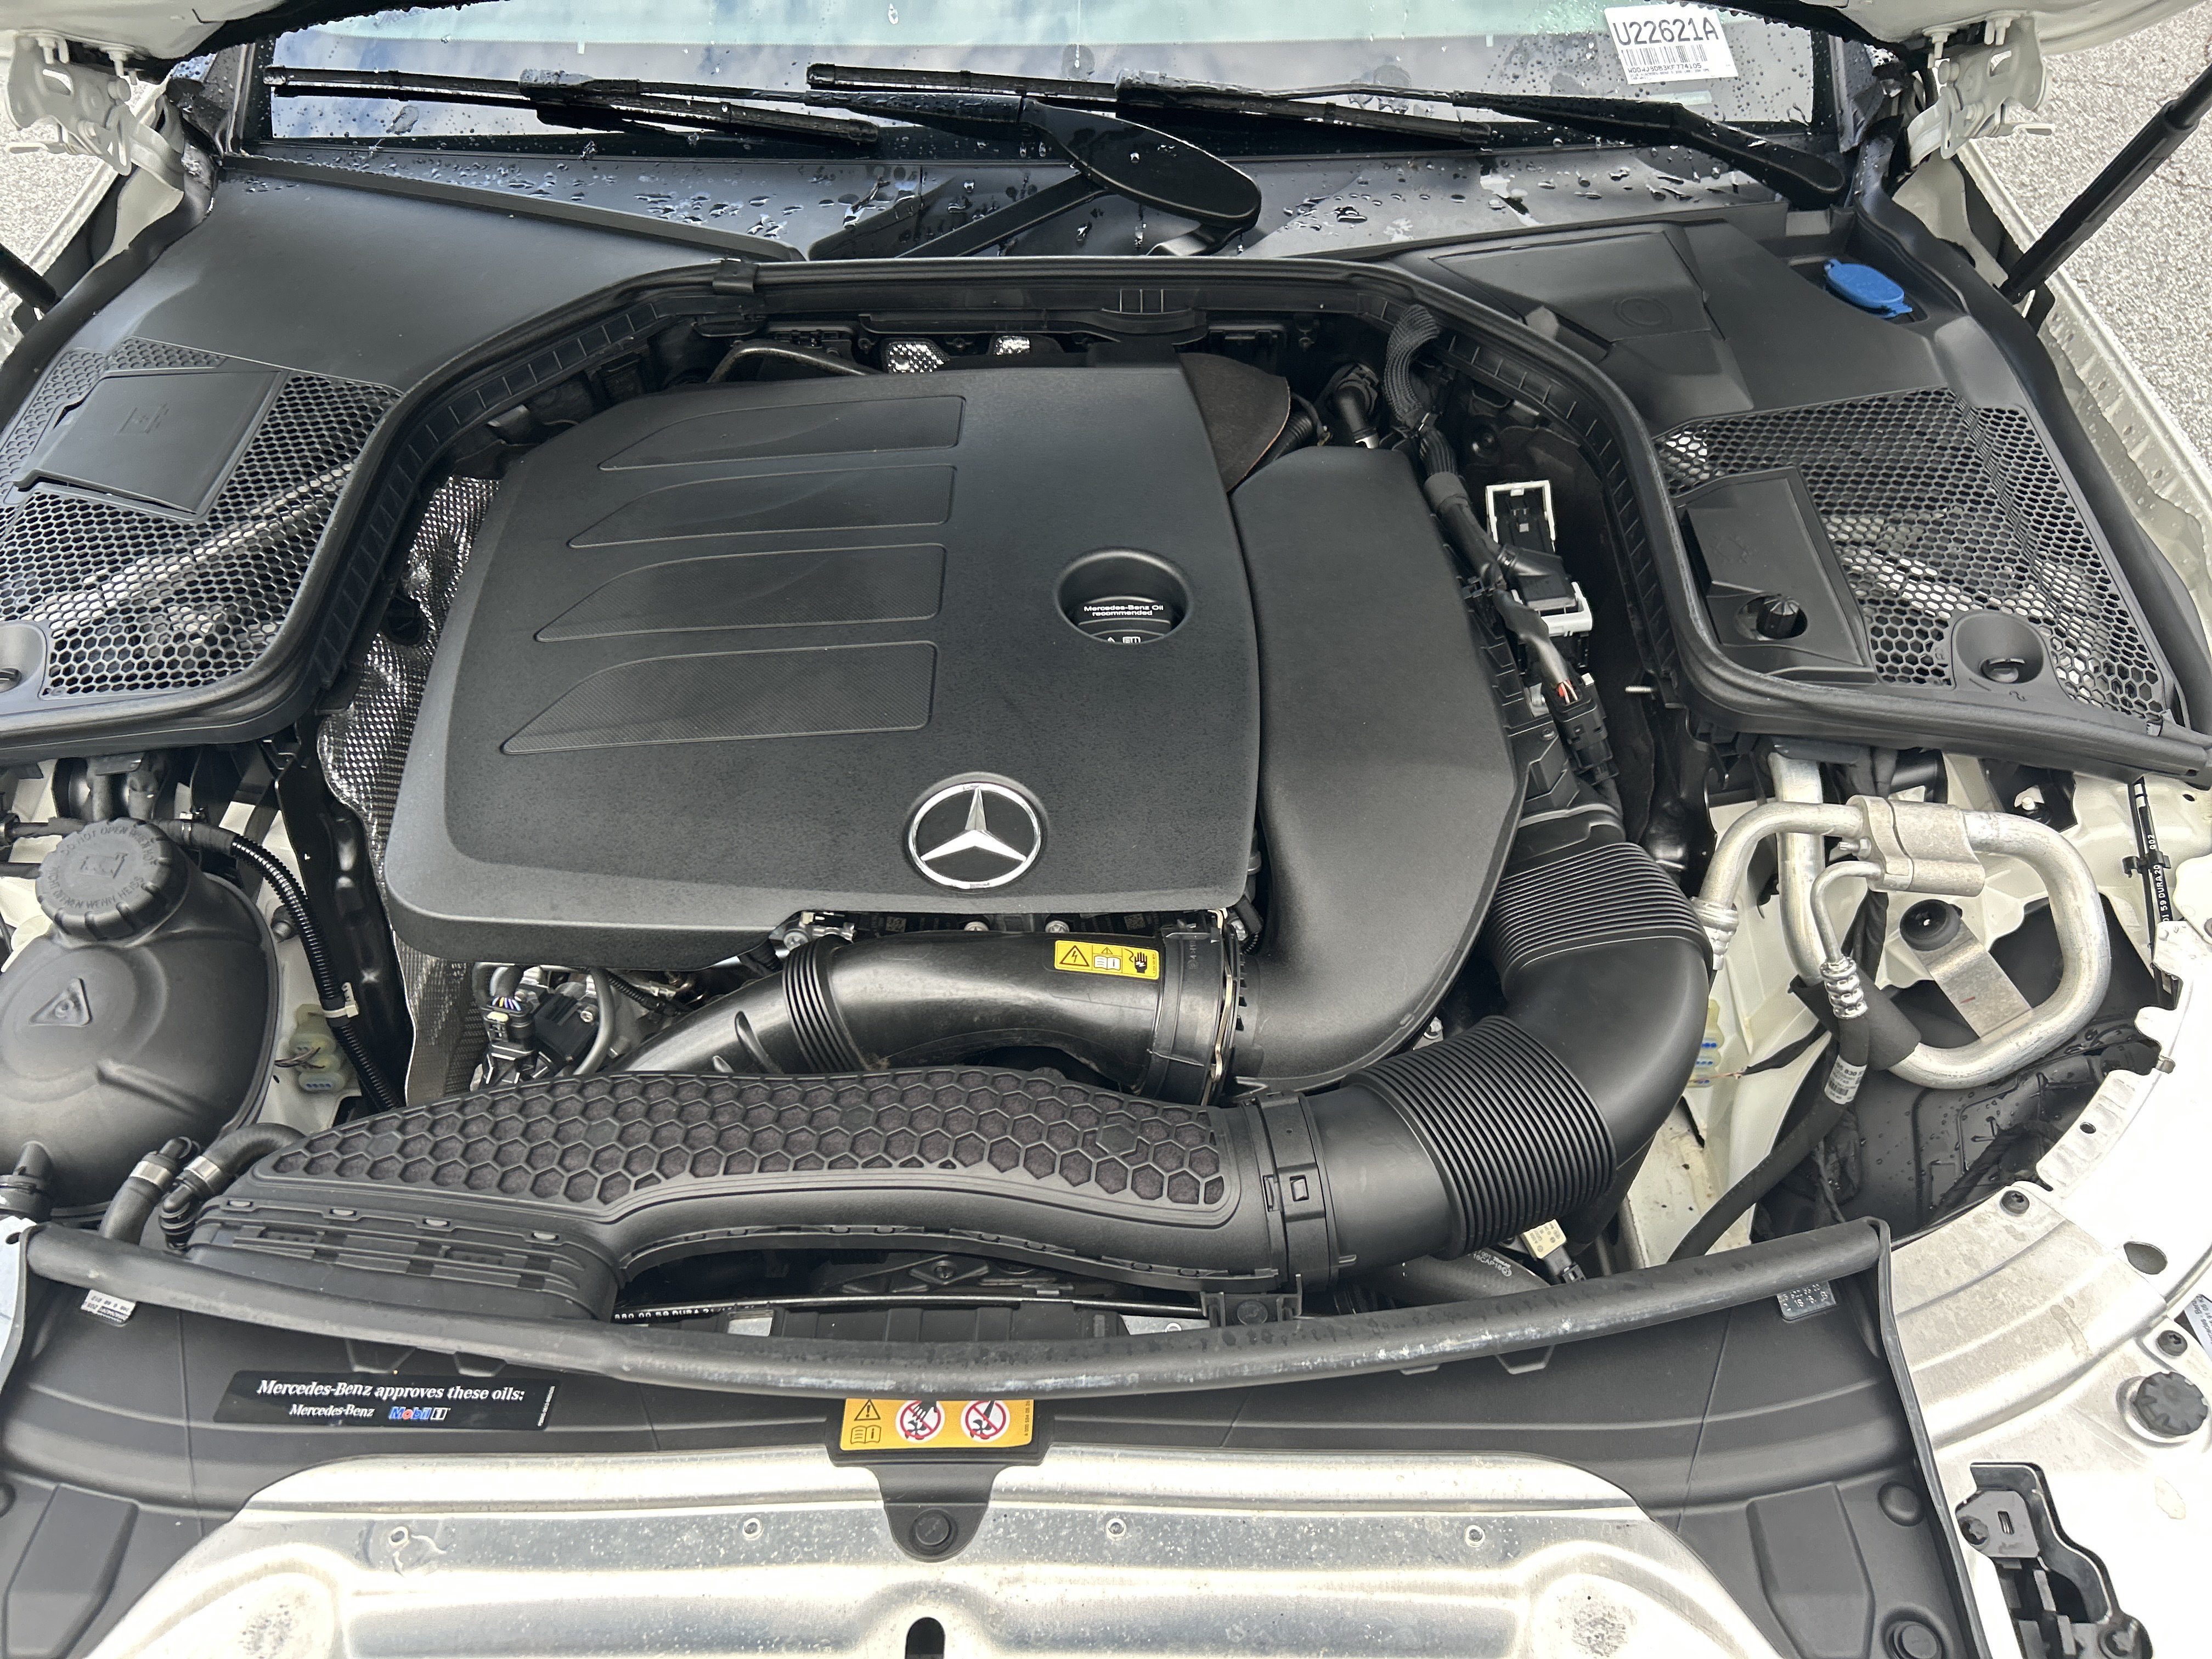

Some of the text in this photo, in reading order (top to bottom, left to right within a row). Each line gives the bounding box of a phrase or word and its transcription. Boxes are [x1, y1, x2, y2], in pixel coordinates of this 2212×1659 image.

[1612, 17, 1719, 46] U22621A
[100, 826, 128, 835] OPEN
[83, 895, 116, 909] WENN
[117, 876, 144, 899] HEISS
[2155, 876, 2166, 899] DURA
[2160, 900, 2169, 912] 59
[256, 1379, 525, 1401] Mercedes-Benz approves these oils:
[289, 1403, 376, 1418] Mercedes-Benz
[388, 1406, 433, 1420] Mobil
